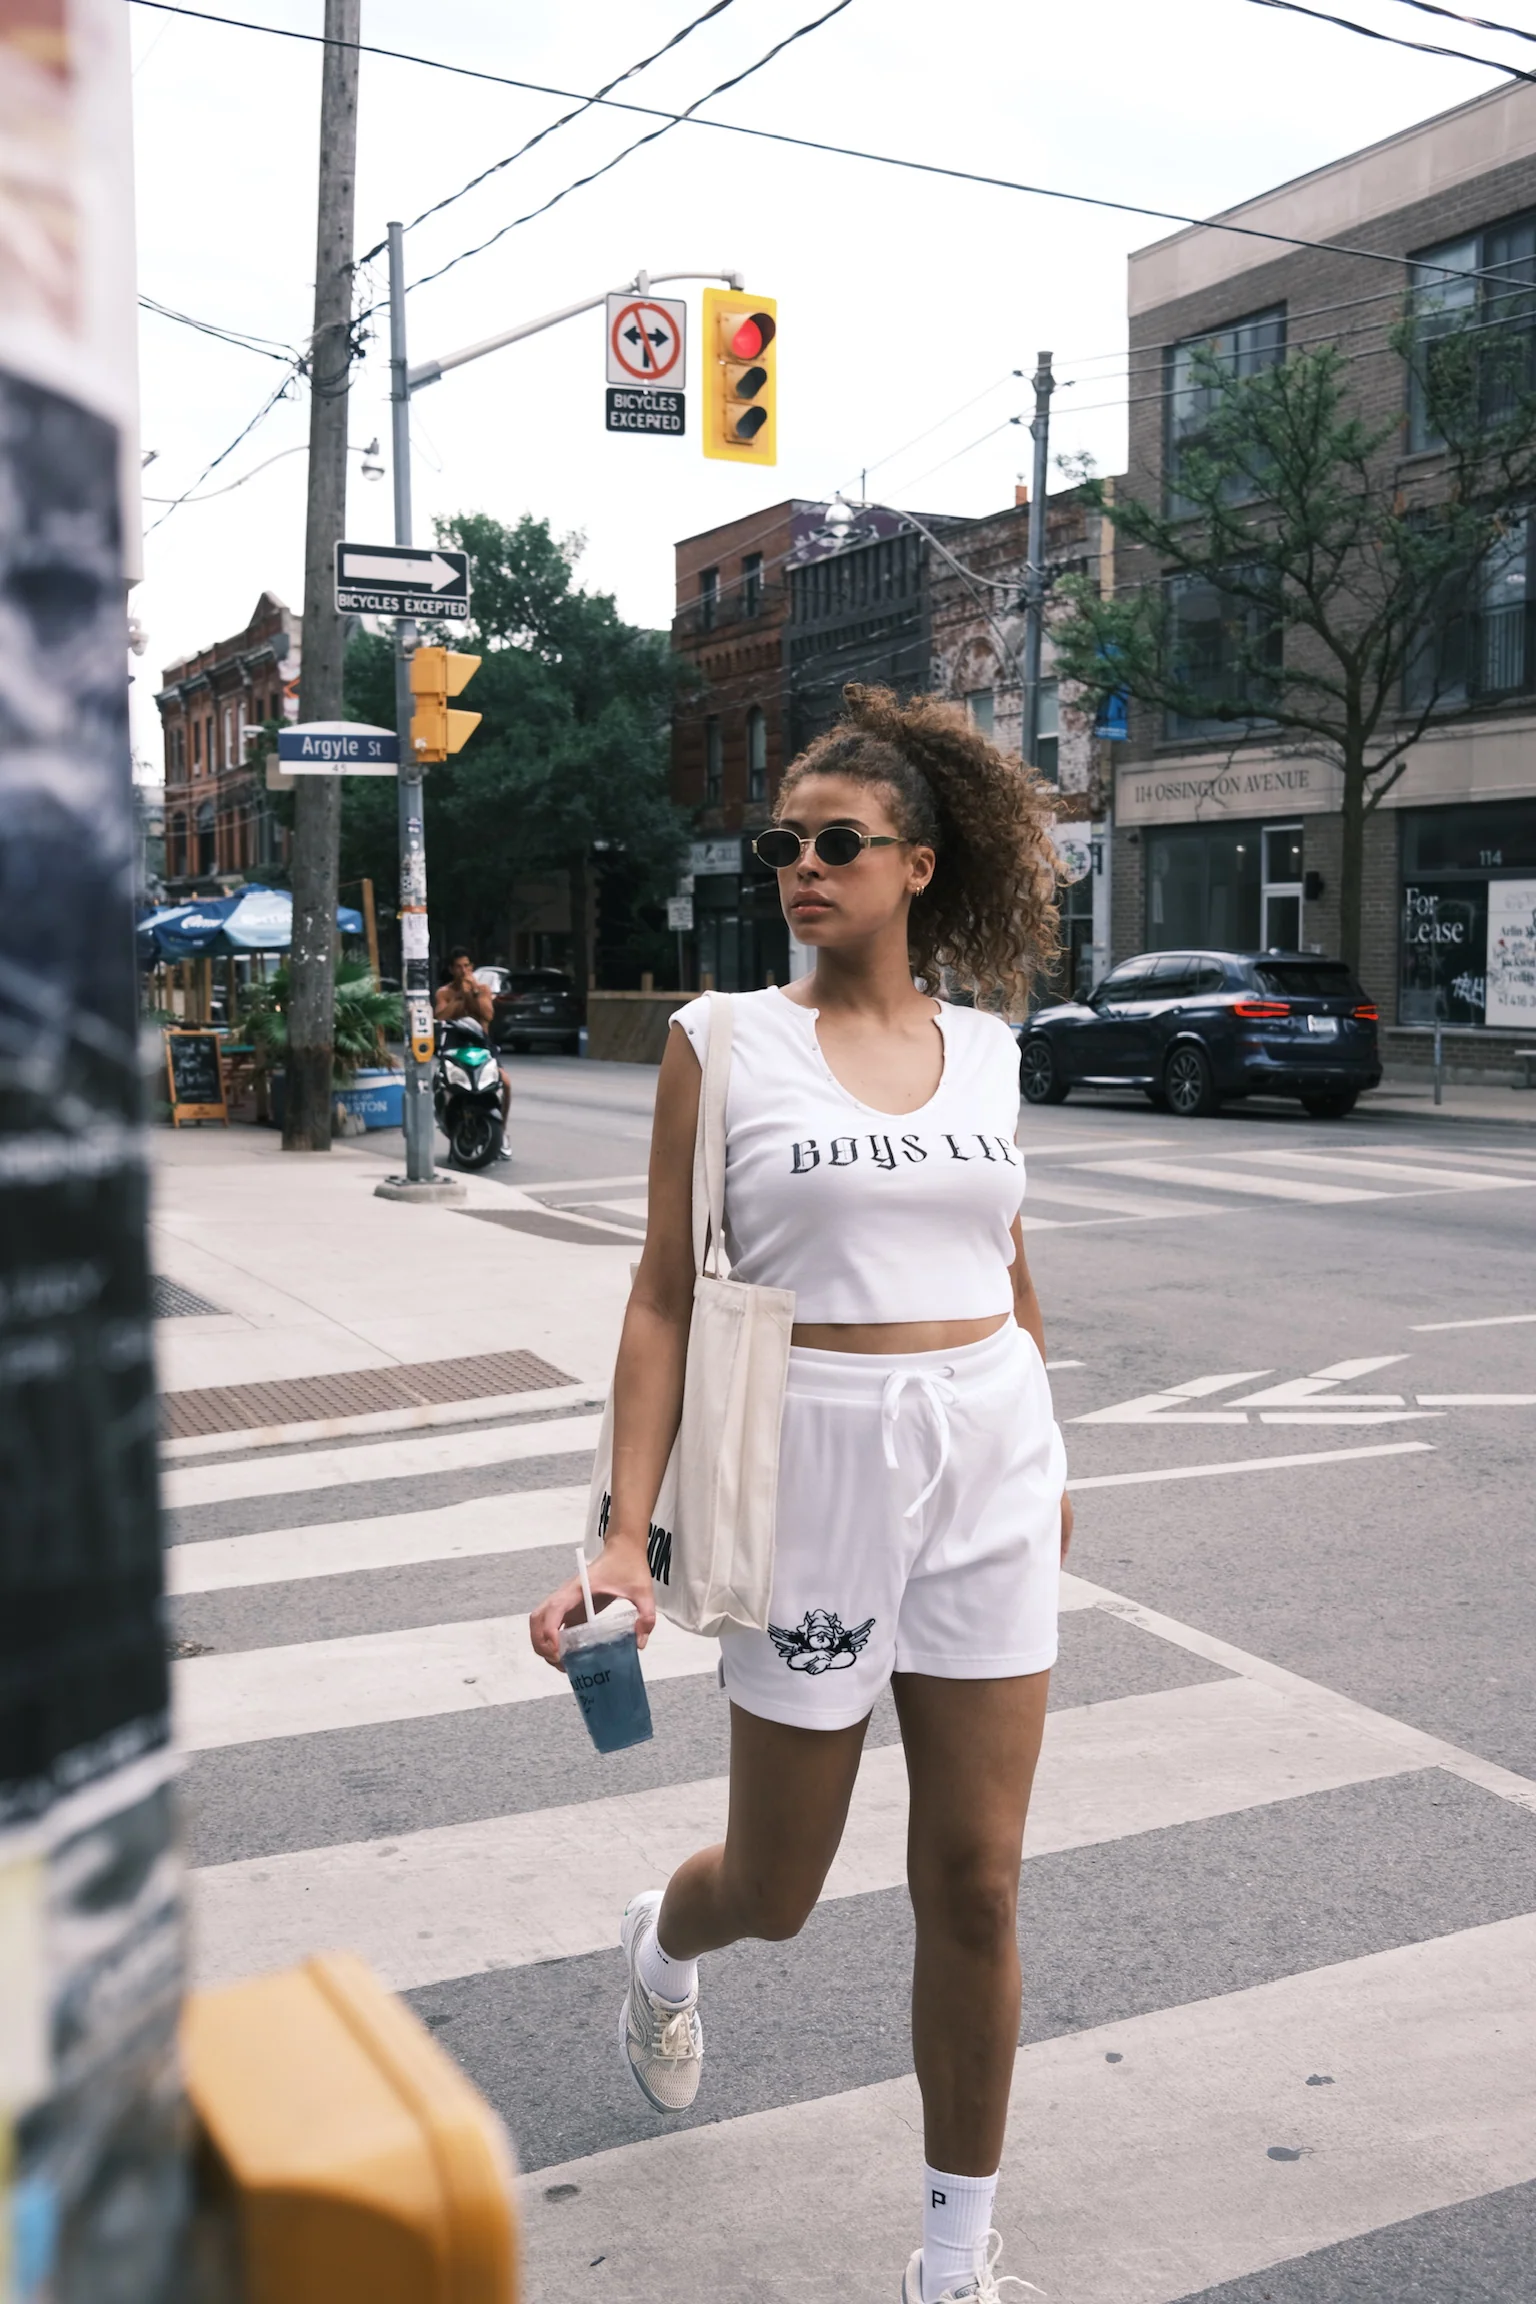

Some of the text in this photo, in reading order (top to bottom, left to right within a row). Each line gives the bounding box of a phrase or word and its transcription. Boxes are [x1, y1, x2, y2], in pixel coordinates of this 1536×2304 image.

[614, 394, 677, 412] BICYCLES
[610, 411, 680, 430] EXCEPTED
[338, 593, 467, 617] BICYCLES EXCEPTED
[302, 736, 381, 759] Argyle St
[1155, 776, 1242, 801] OSSINGTON
[1244, 770, 1310, 793] AVENUE
[1479, 850, 1502, 866] 114
[1405, 888, 1439, 916] For
[1405, 921, 1464, 944] Lease
[790, 1134, 928, 1174] BOYS
